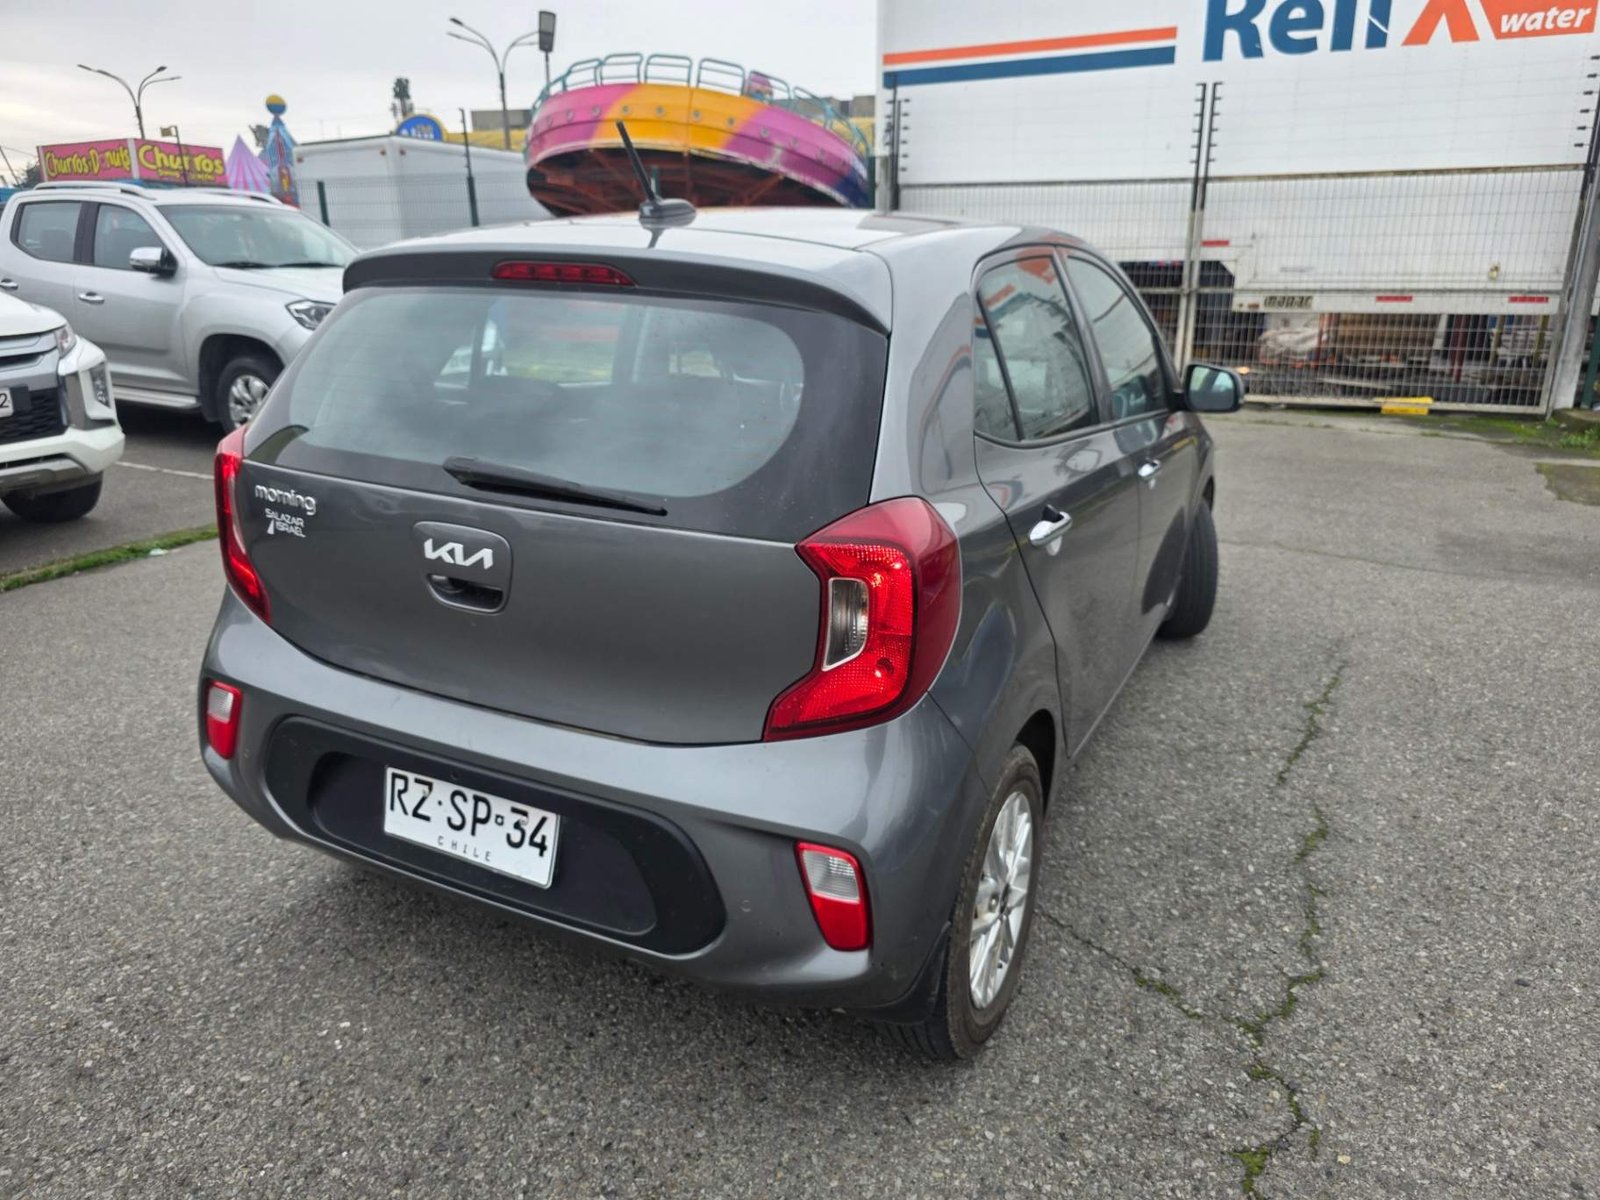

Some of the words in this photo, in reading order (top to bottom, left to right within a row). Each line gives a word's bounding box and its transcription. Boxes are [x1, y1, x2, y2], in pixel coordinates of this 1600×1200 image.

[1501, 7, 1591, 33] water
[45, 151, 89, 177] Churros
[138, 144, 225, 176] Churros
[255, 484, 317, 515] morning
[264, 507, 305, 528] SALAZAR
[275, 520, 307, 538] ISRAEL
[423, 538, 494, 570] KIA
[437, 834, 492, 863] CHILE
